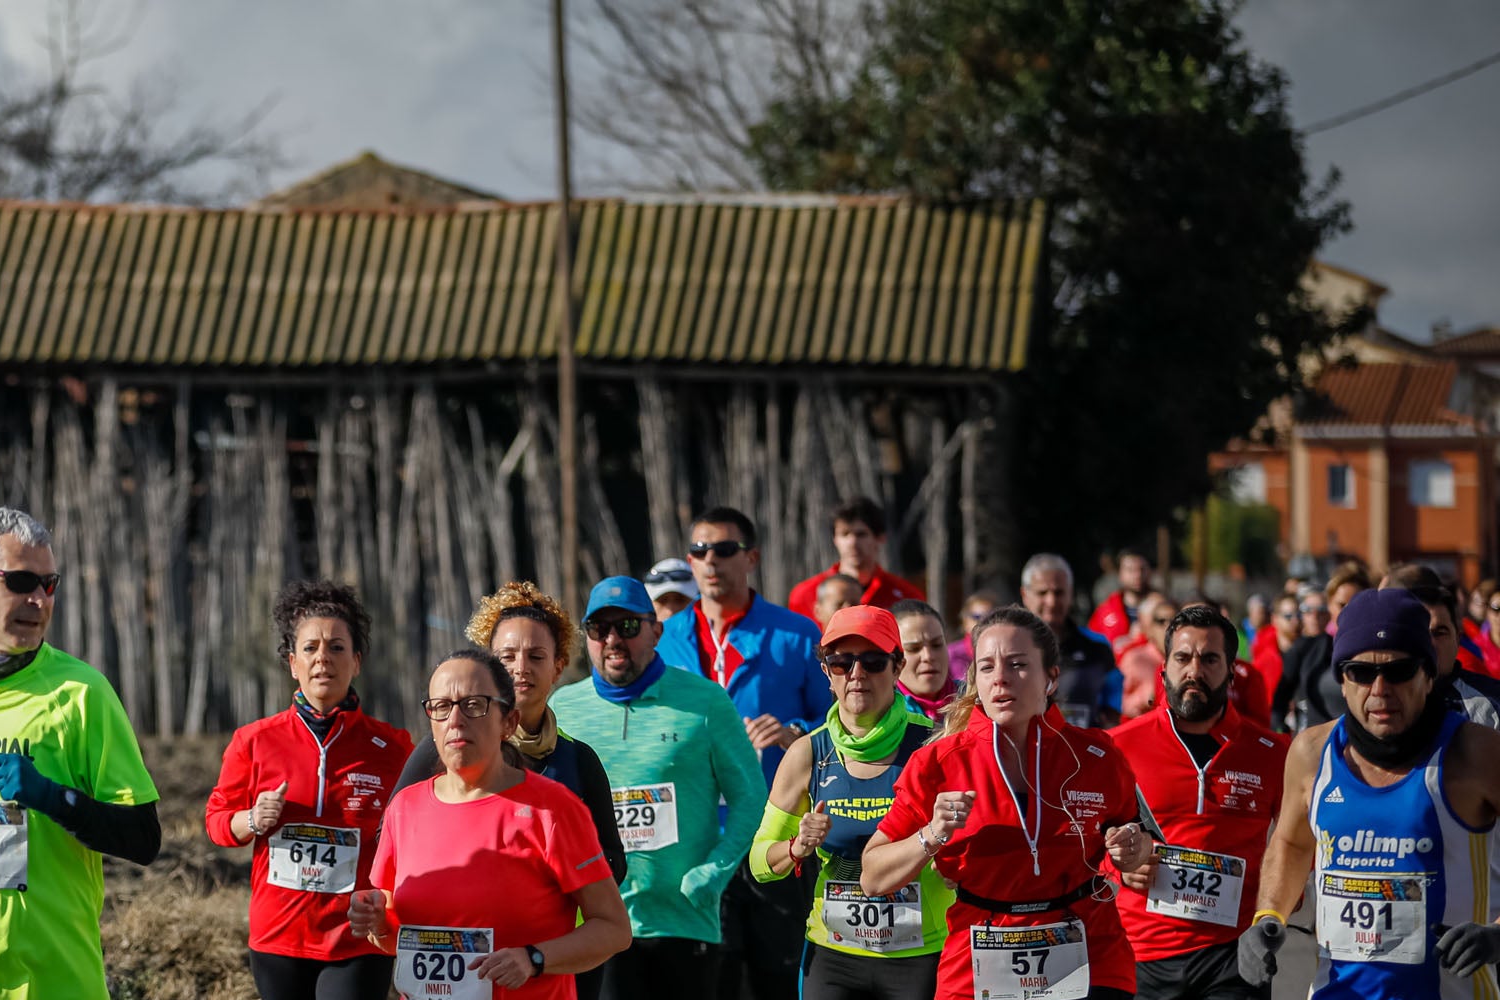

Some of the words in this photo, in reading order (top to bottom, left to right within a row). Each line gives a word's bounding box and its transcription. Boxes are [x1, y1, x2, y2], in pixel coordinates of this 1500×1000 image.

[827, 797, 894, 808] ATLETISM
[1337, 830, 1434, 858] olimpo
[290, 842, 337, 868] 614
[1336, 854, 1396, 869] deportes
[301, 866, 322, 877] NANY
[1171, 868, 1223, 898] 342
[1343, 878, 1380, 887] CARRERA
[1182, 892, 1217, 908] MORALES
[846, 903, 895, 927] 301
[1340, 901, 1393, 930] 491
[854, 928, 893, 938] ALHENDIN
[975, 931, 987, 940] 26
[1003, 930, 1043, 938] CARRERA
[413, 952, 466, 982] 620
[1011, 949, 1050, 976] 57
[425, 983, 452, 996] INMITA
